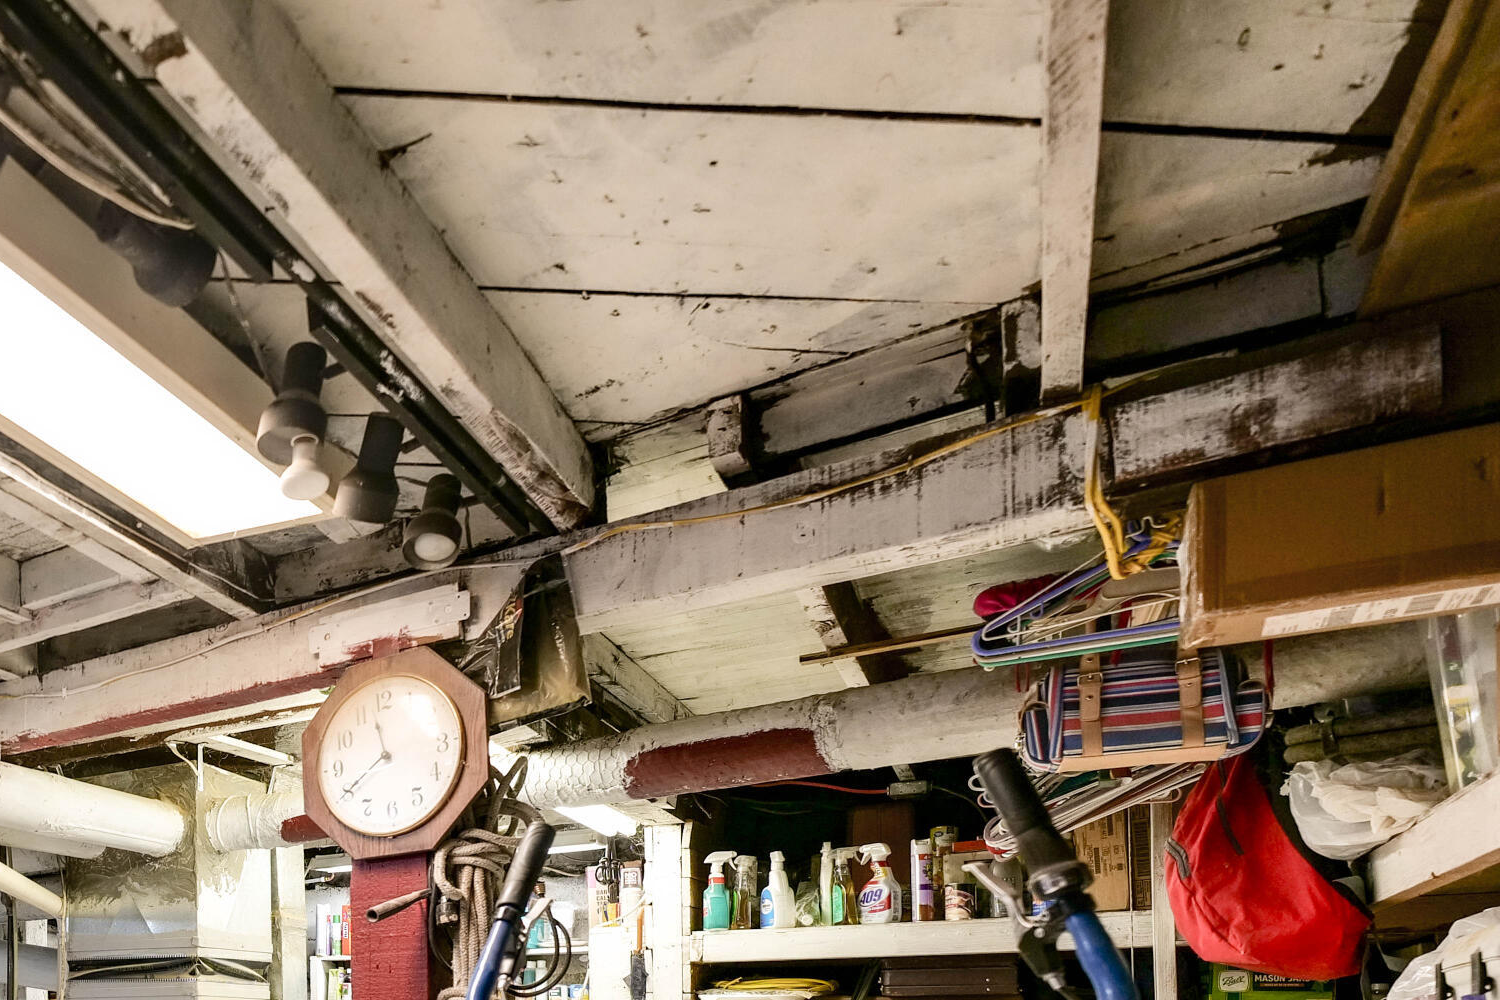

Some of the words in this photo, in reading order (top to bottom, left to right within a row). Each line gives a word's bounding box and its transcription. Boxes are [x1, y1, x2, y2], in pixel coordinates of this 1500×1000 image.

[376, 690, 393, 712] 12
[356, 705, 368, 726] 11
[337, 730, 353, 751] 10
[436, 732, 449, 753] 3
[332, 759, 344, 777] 9
[430, 761, 442, 782] 4
[343, 782, 355, 802] 8
[411, 786, 423, 807] 5
[362, 798, 373, 817] 7
[386, 800, 398, 819] 6
[1222, 976, 1245, 987] Ball
